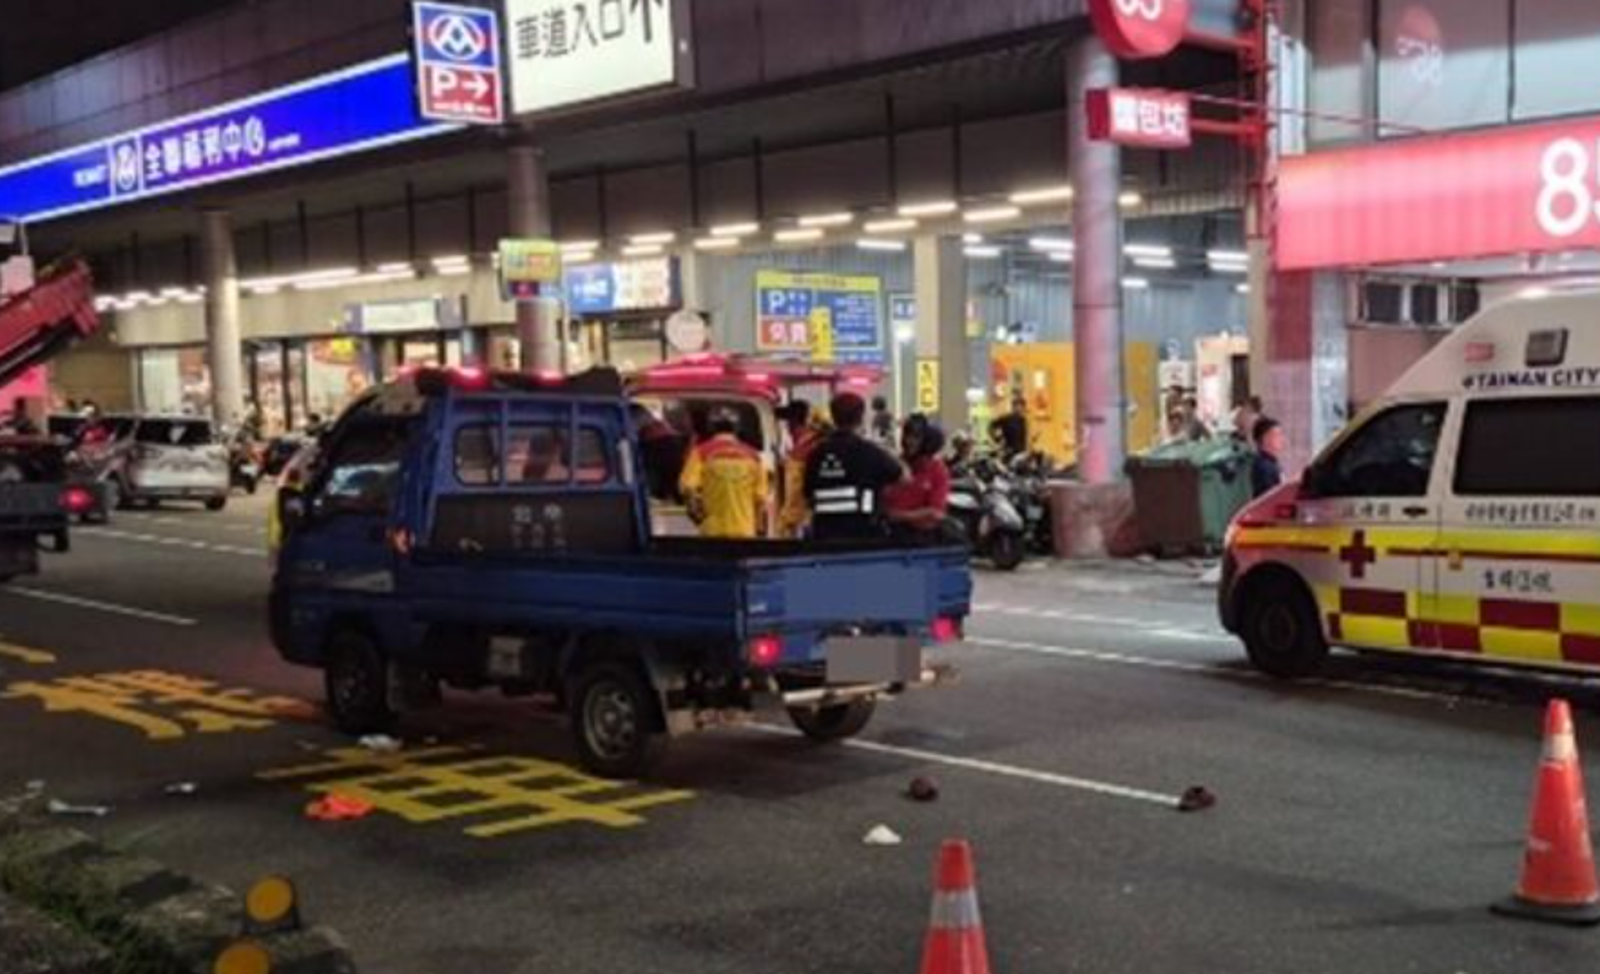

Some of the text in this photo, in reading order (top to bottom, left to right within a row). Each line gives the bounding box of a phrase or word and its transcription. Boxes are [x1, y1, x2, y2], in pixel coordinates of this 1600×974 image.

[515, 0, 624, 58] 車道入口
[432, 66, 457, 98] P
[1535, 138, 1600, 237] 8
[769, 290, 785, 315] P
[1477, 370, 1547, 387] TAINAN
